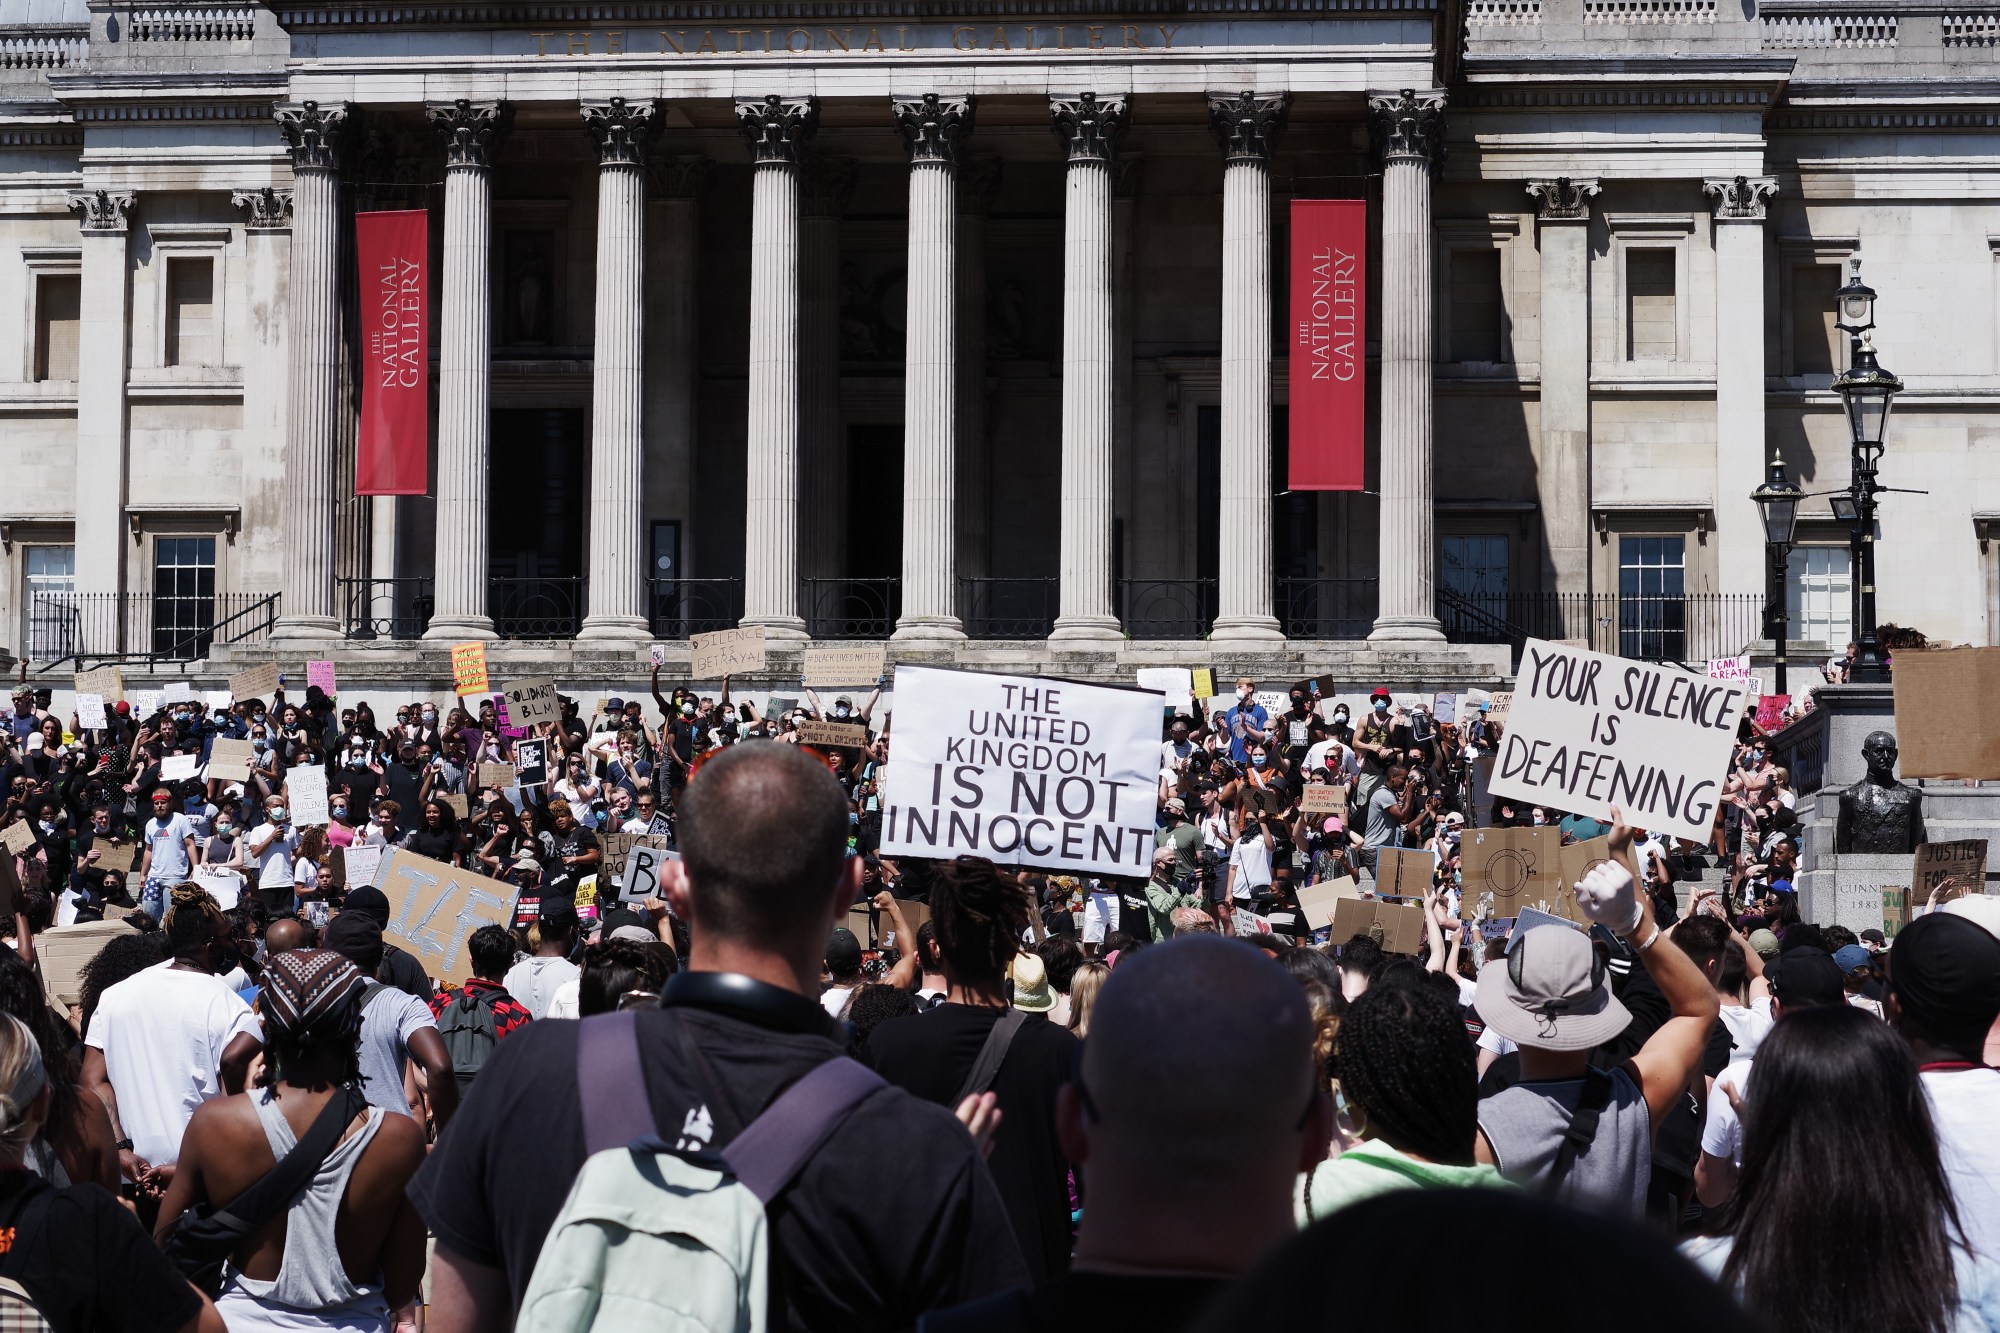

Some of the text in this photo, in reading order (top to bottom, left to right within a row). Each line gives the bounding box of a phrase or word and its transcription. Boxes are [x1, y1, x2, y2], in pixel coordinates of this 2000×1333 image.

[529, 24, 1183, 57] THE NATIONAL GALLERY
[1311, 246, 1331, 382] NATIONAL
[1333, 247, 1356, 382] GALLERY
[380, 256, 399, 388] NATIONAL
[399, 256, 420, 388] GALLERY
[1299, 320, 1309, 347] THE
[371, 330, 381, 357] THE
[699, 627, 764, 650] SILENCE
[457, 647, 476, 659] STOP
[721, 645, 735, 657] IS
[309, 662, 331, 671] Justice
[456, 658, 481, 669] KILLING
[697, 652, 764, 672] BETRAYAL
[1710, 661, 1714, 671] I
[77, 669, 116, 683] BLACK LIVES
[460, 667, 482, 677] BLACK
[1710, 668, 1750, 679] BREATHE
[86, 679, 113, 687] MATTER
[459, 676, 484, 687] PEOPLE
[505, 684, 556, 705] SOLIDARITY
[1530, 648, 1742, 731] YOUR SILENCE
[1001, 683, 1061, 715] THE
[1497, 694, 1513, 704] CAN
[82, 703, 96, 711] NOT
[521, 702, 554, 719] BLM
[1487, 703, 1511, 714] BREAT
[81, 717, 106, 728] SILENT
[801, 722, 813, 730] Our
[815, 723, 828, 731] Skin
[968, 709, 1092, 746] UNITED
[1590, 712, 1621, 746] IS
[808, 732, 825, 742] NOT
[825, 734, 832, 743] A
[520, 744, 535, 753] STAY
[520, 749, 541, 759] BLACK
[521, 755, 535, 764] STAY
[946, 736, 1107, 778] KINGDOM
[521, 760, 541, 769] HOME
[293, 773, 319, 785] WHITE
[1500, 734, 1716, 826] DEAFENING
[294, 782, 324, 794] SILENCE
[931, 763, 985, 810] IS
[1010, 771, 1130, 823] NOT
[292, 798, 327, 812] VIOLENCE
[887, 805, 1154, 866] INNOCENT
[1925, 840, 1981, 863] JUSTICE
[1923, 869, 1947, 890] FOR
[577, 883, 592, 892] BLACK
[1839, 884, 1884, 894] CUNNI
[576, 890, 590, 899] LIVES
[574, 897, 595, 907] MATTE
[1852, 900, 1878, 909] 1883
